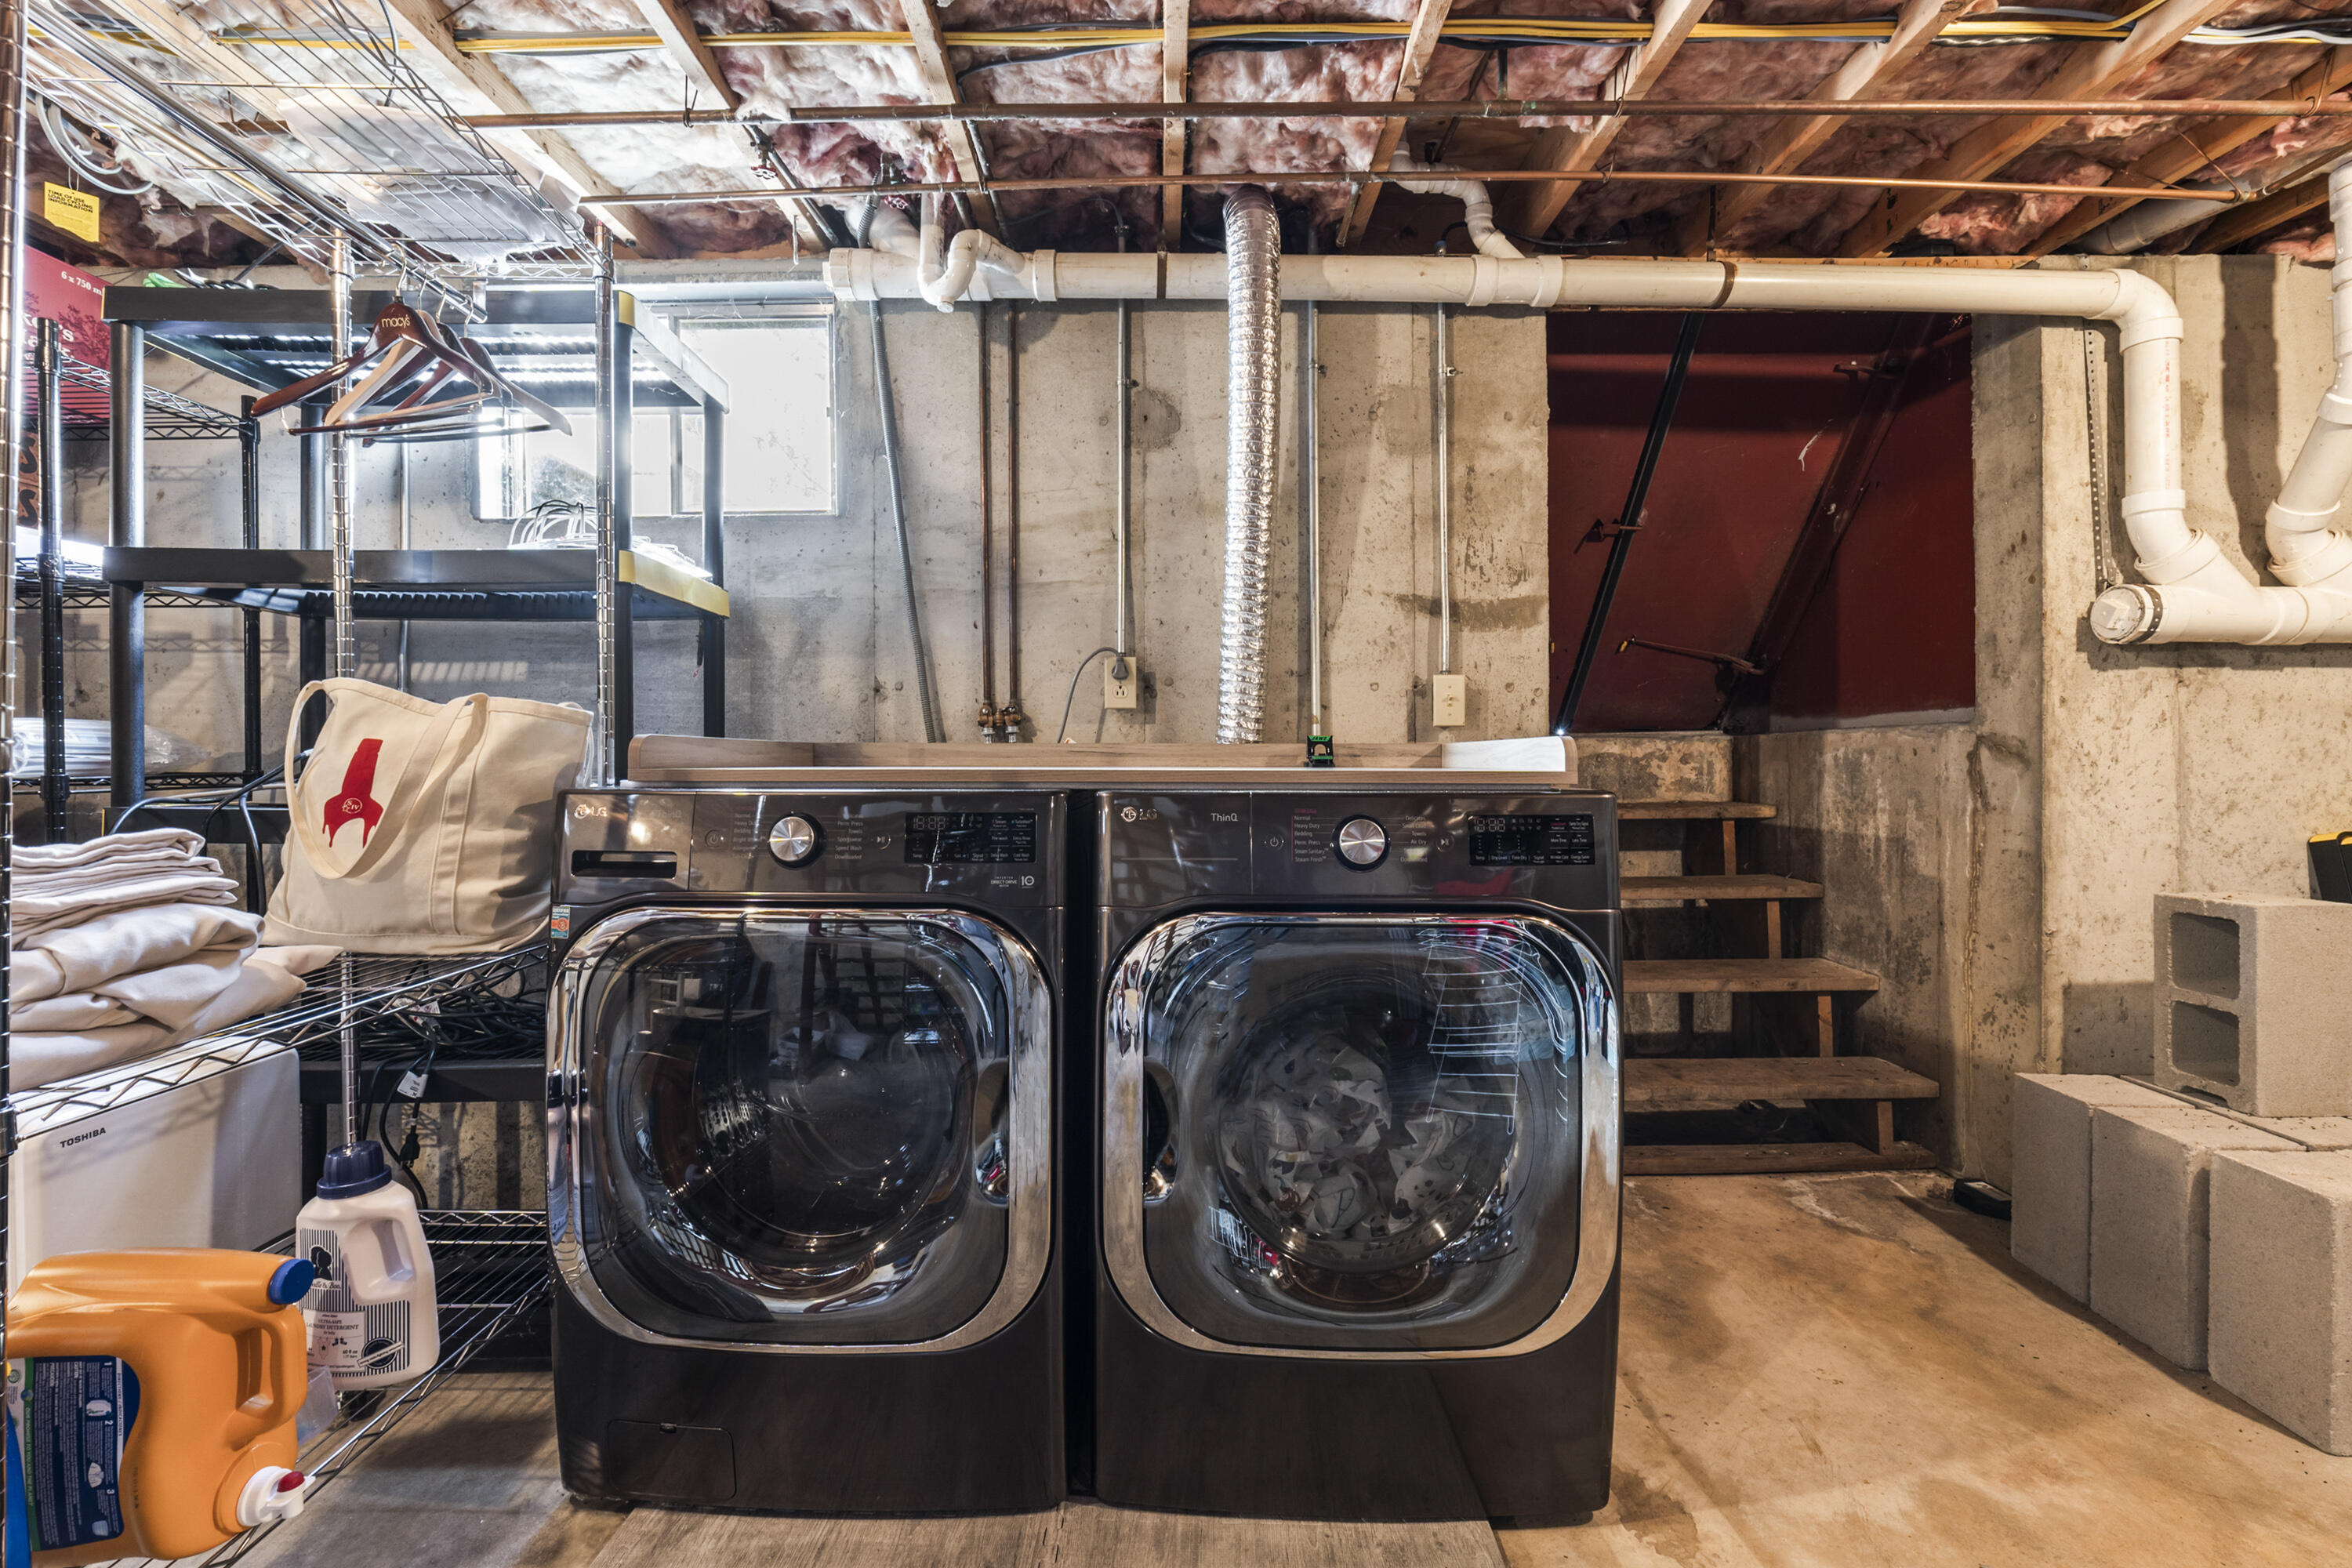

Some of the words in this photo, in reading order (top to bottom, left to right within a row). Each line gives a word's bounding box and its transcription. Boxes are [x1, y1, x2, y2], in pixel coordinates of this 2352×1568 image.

[48, 198, 93, 213] INFORMATION
[67, 198, 93, 209] CYCLING
[61, 270, 67, 280] 6
[76, 277, 92, 290] 750
[93, 287, 103, 296] m
[590, 806, 608, 817] LG
[1139, 808, 1158, 820] LG
[1210, 812, 1239, 822] ThinQ
[1021, 875, 1035, 886] 10
[60, 1127, 107, 1149] TOSHIBA
